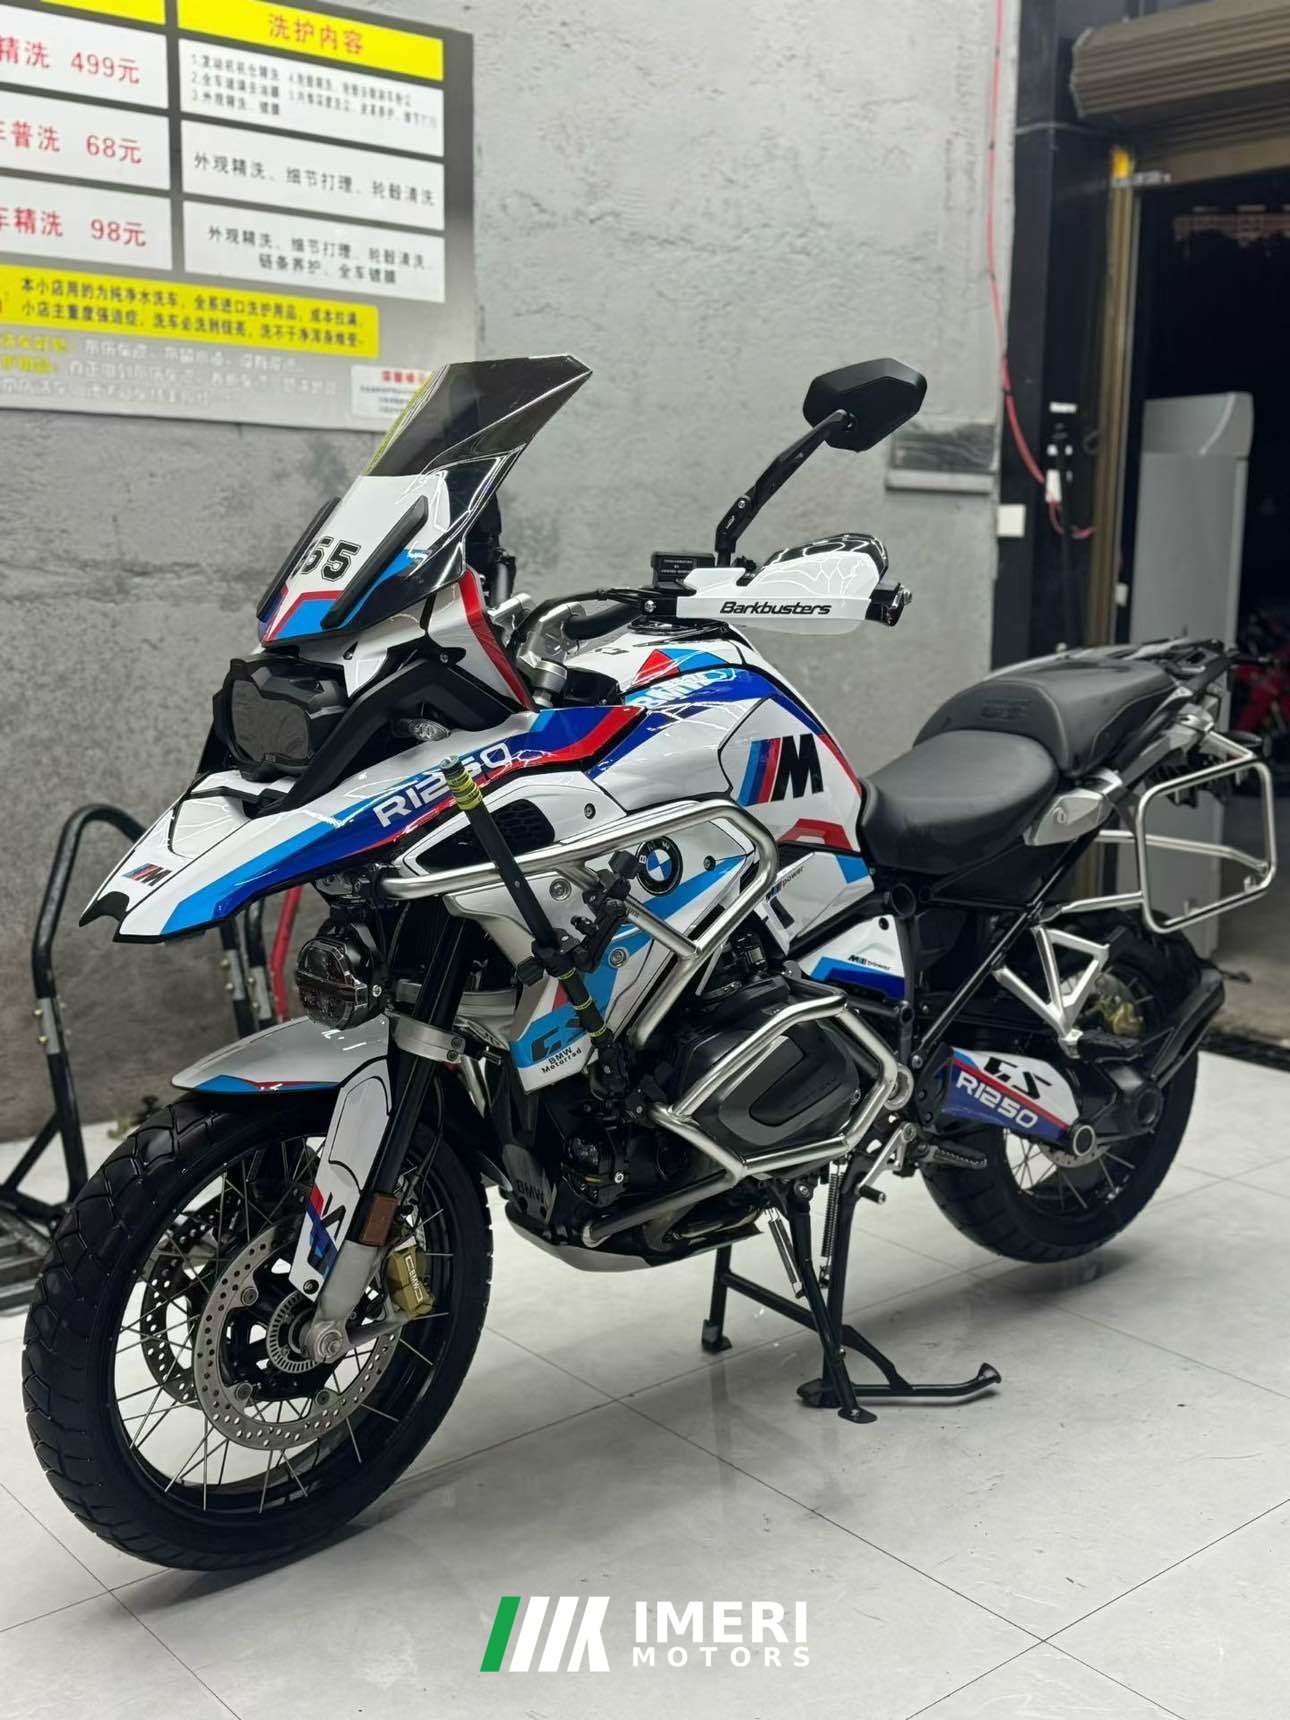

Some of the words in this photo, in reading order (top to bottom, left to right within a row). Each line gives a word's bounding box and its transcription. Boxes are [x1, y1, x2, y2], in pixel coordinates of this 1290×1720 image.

[268, 13, 364, 55] 洗护内容
[71, 52, 140, 84] 499元
[0, 120, 60, 152] 普洗
[86, 134, 142, 164] 68元
[91, 219, 147, 247] 98元
[720, 601, 832, 615] Barkbusters
[770, 733, 824, 802] M
[541, 1047, 583, 1073] Motorrad
[548, 1047, 573, 1065] BMW
[956, 1071, 1038, 1129] R1250
